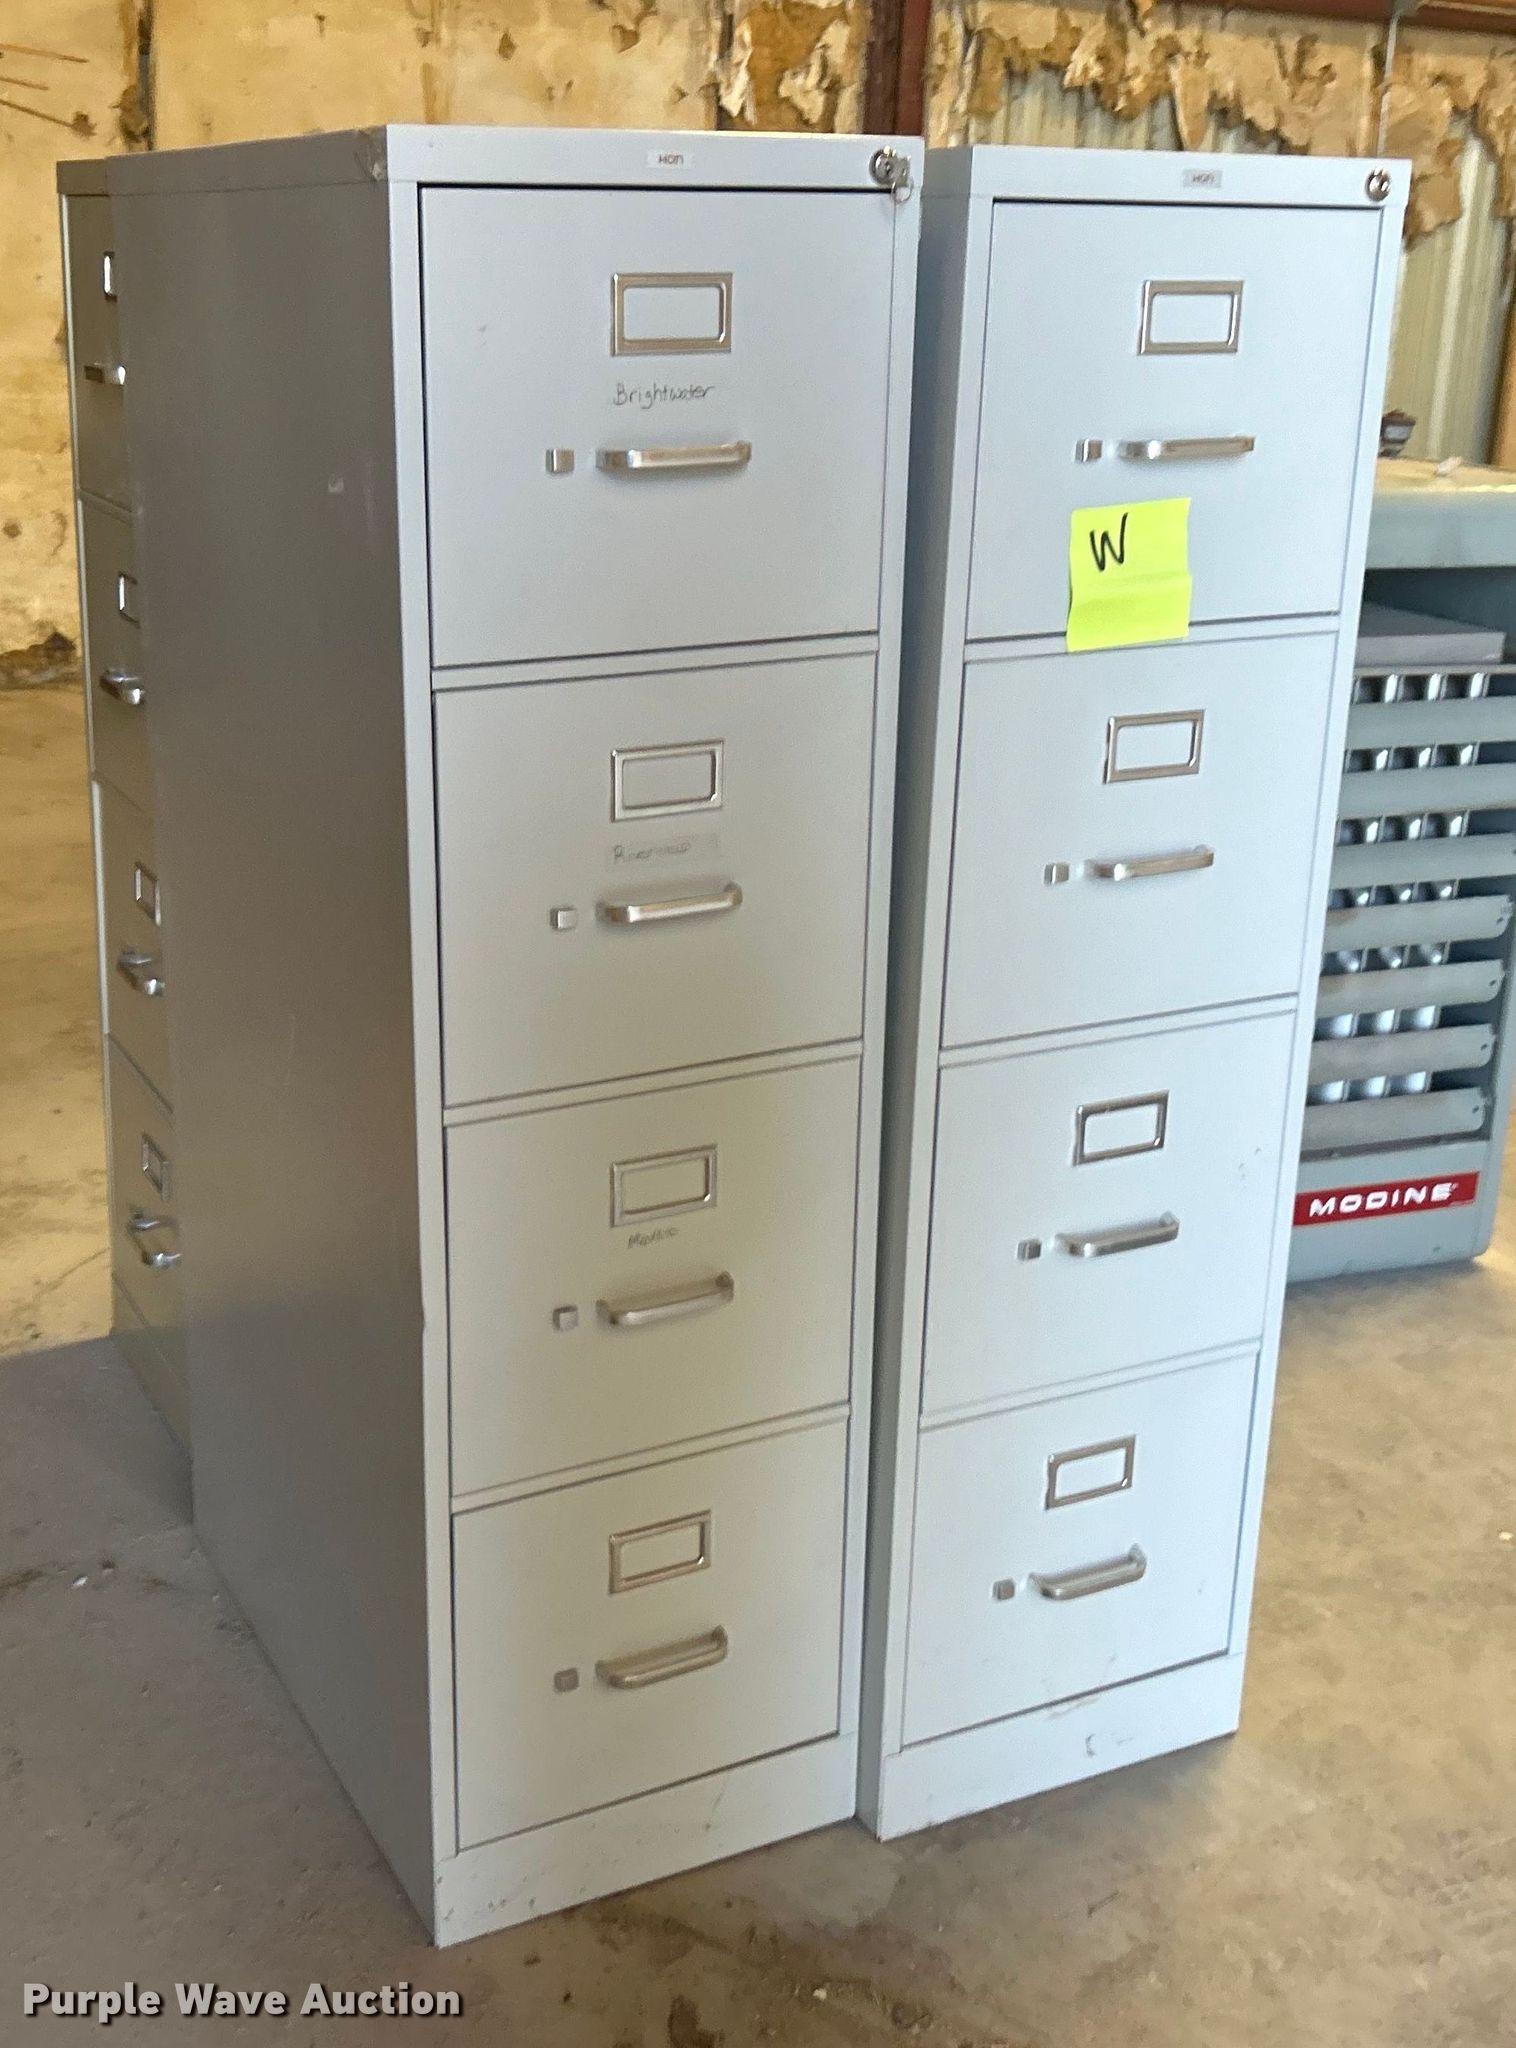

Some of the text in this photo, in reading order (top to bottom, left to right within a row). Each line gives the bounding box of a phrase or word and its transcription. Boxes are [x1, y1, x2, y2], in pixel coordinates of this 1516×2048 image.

[613, 382, 716, 410] Brightwater
[1088, 511, 1129, 572] W
[1308, 1182, 1453, 1217] MODINE
